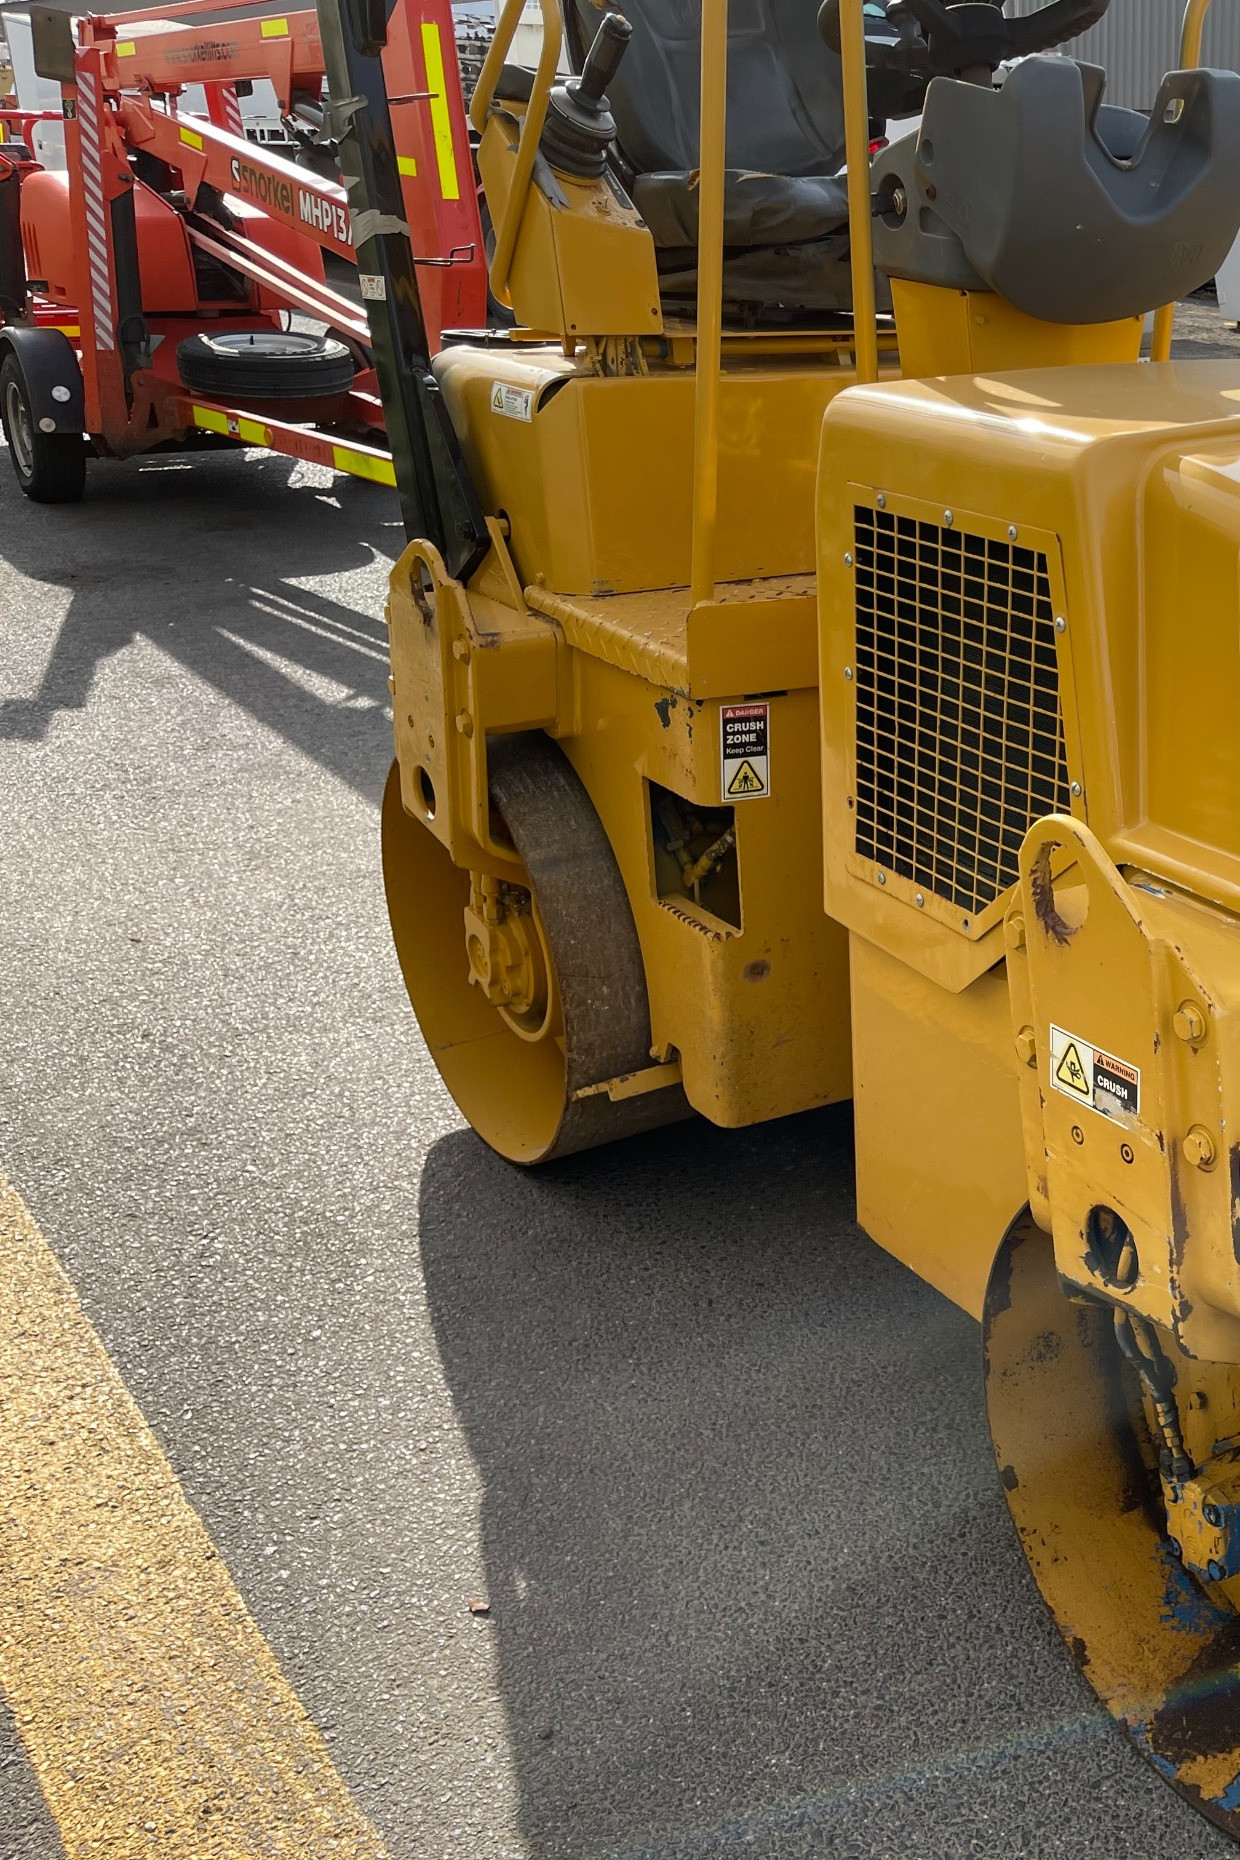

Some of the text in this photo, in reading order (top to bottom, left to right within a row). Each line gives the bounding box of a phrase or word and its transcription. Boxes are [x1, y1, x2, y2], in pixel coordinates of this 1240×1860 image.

[735, 708, 764, 717] DANGER
[726, 720, 764, 733] CRUSH
[726, 733, 757, 744] ZONE
[726, 745, 764, 755] Keep Clear
[1105, 1059, 1135, 1081] WARNING
[1096, 1074, 1128, 1100] CRUSH
